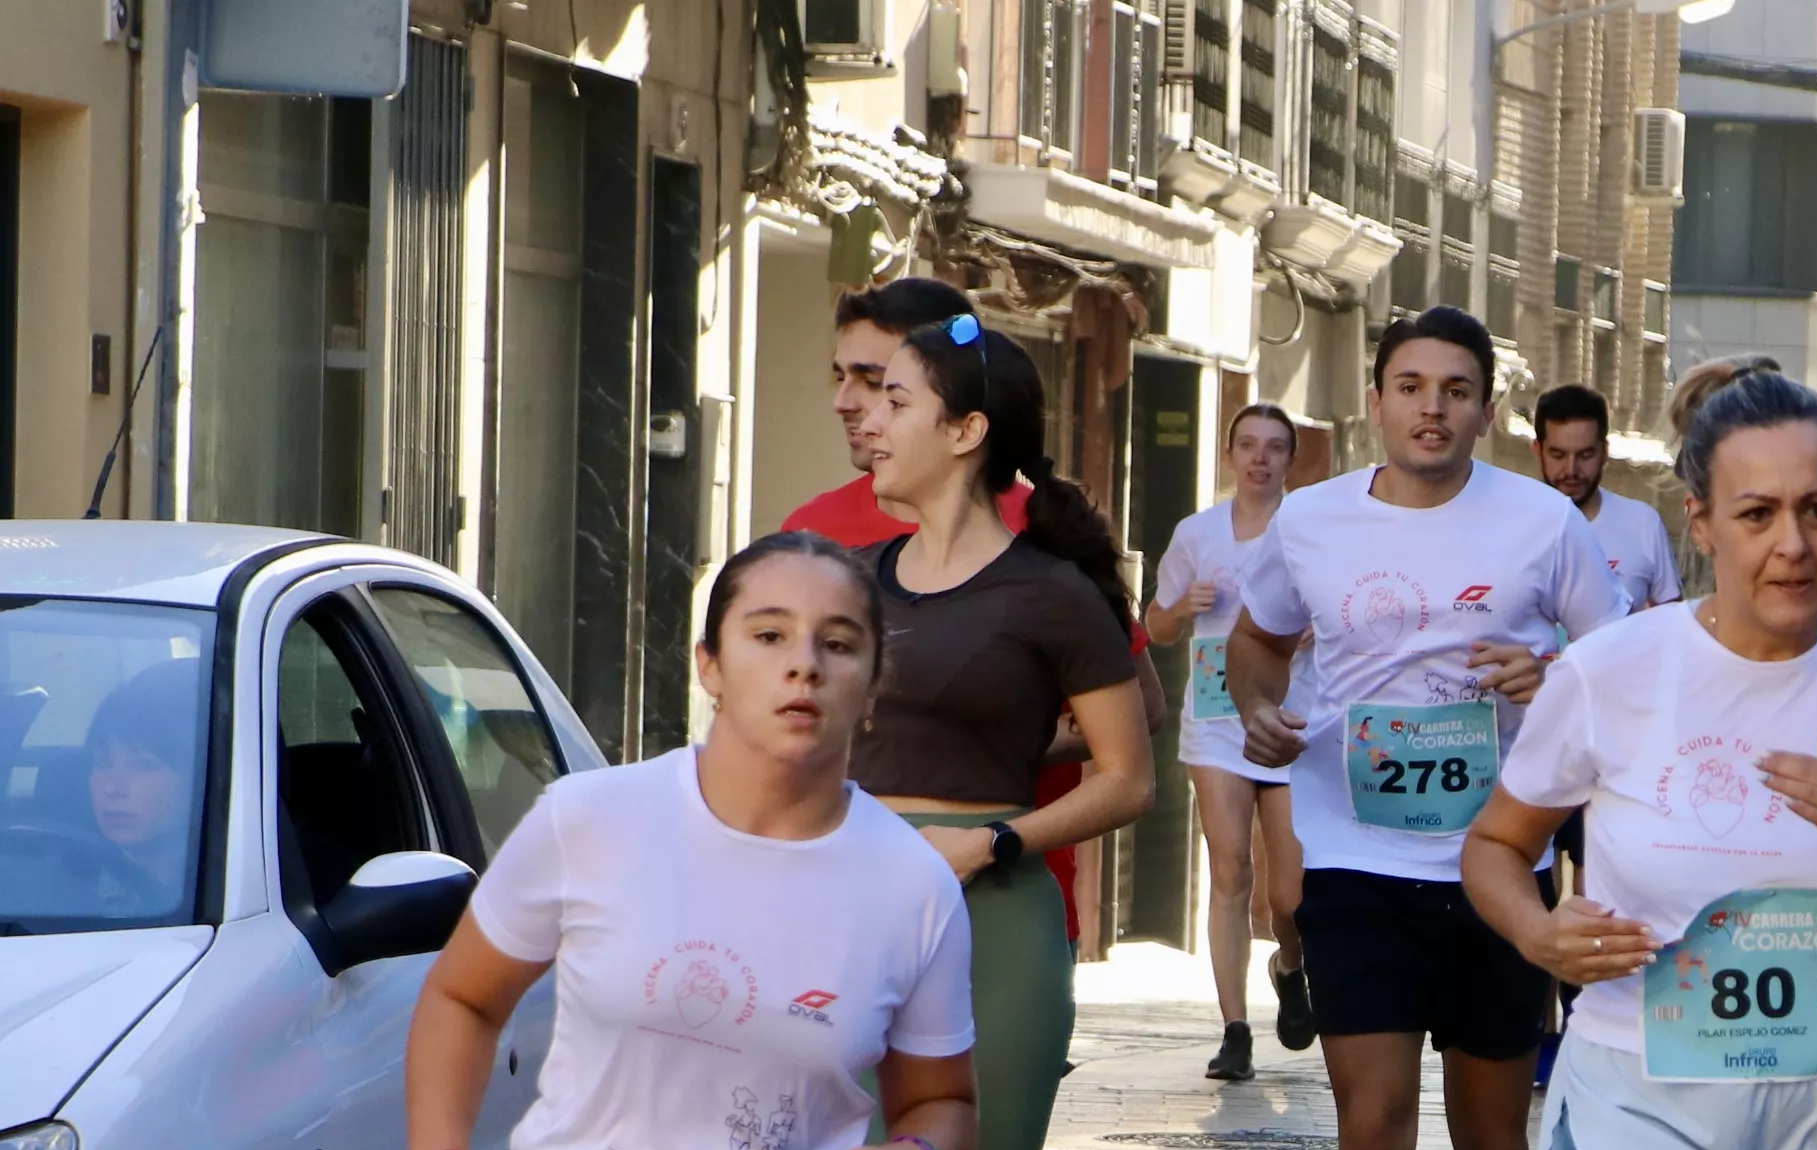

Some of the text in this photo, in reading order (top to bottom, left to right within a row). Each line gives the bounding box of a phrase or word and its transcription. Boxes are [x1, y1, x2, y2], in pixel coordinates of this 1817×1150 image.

[1355, 570, 1409, 588] CUIDA TU
[1678, 736, 1753, 756] CUIDA TU
[1379, 757, 1470, 794] 278
[1405, 814, 1442, 827] Infrico
[1733, 911, 1752, 928] IV
[1751, 911, 1814, 929] CARRERA
[675, 940, 740, 963] CUIDA TU
[1711, 967, 1796, 1020] 80
[1698, 1025, 1808, 1038] PILAR ESPEJO GOMEZ
[1725, 1052, 1778, 1068] Infrico
